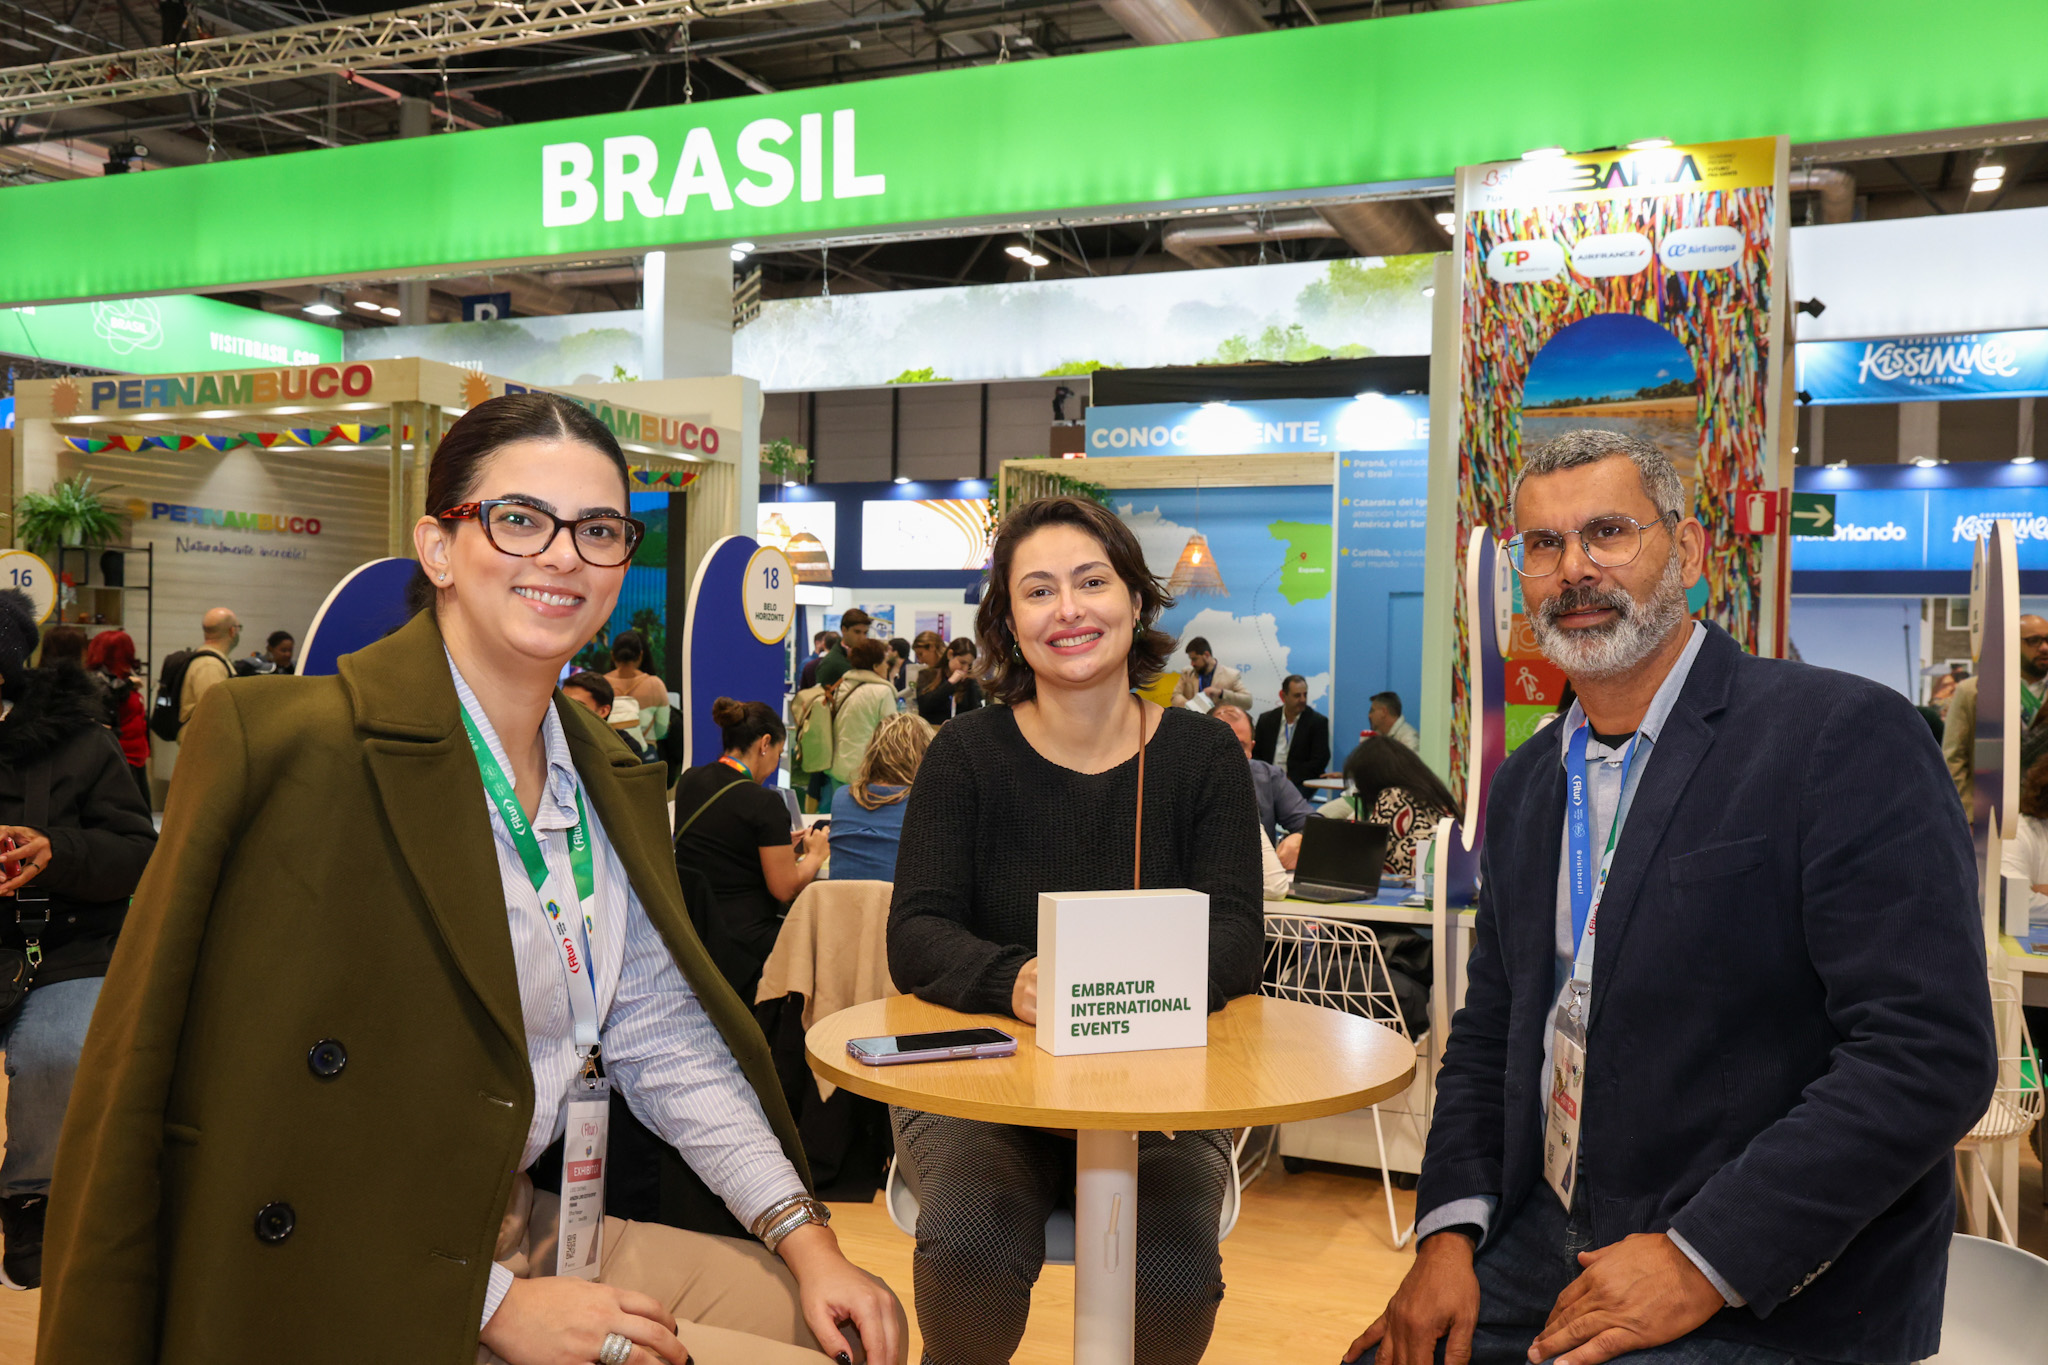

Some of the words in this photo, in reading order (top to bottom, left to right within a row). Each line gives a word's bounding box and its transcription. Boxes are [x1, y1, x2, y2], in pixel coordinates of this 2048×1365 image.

[542, 109, 885, 227] BRASIL
[1501, 250, 1529, 267] TAP
[110, 316, 148, 335] BRASIL
[91, 364, 373, 411] PERNAMBUCO
[1909, 375, 1965, 385] FLORIDA
[1367, 469, 1393, 478] Brasil
[1353, 499, 1396, 507] Cataratas
[1398, 498, 1413, 506] del
[152, 502, 321, 535] PERNAMBUCO
[1393, 520, 1407, 528] del
[10, 568, 33, 587] 16
[762, 567, 779, 589] 18
[763, 602, 778, 612] BELO
[755, 612, 785, 622] HORIZONTE
[1071, 980, 1155, 998] EMBRATUR
[1071, 997, 1191, 1018] INTERNATIONAL
[1071, 1020, 1130, 1037] EVENTS
